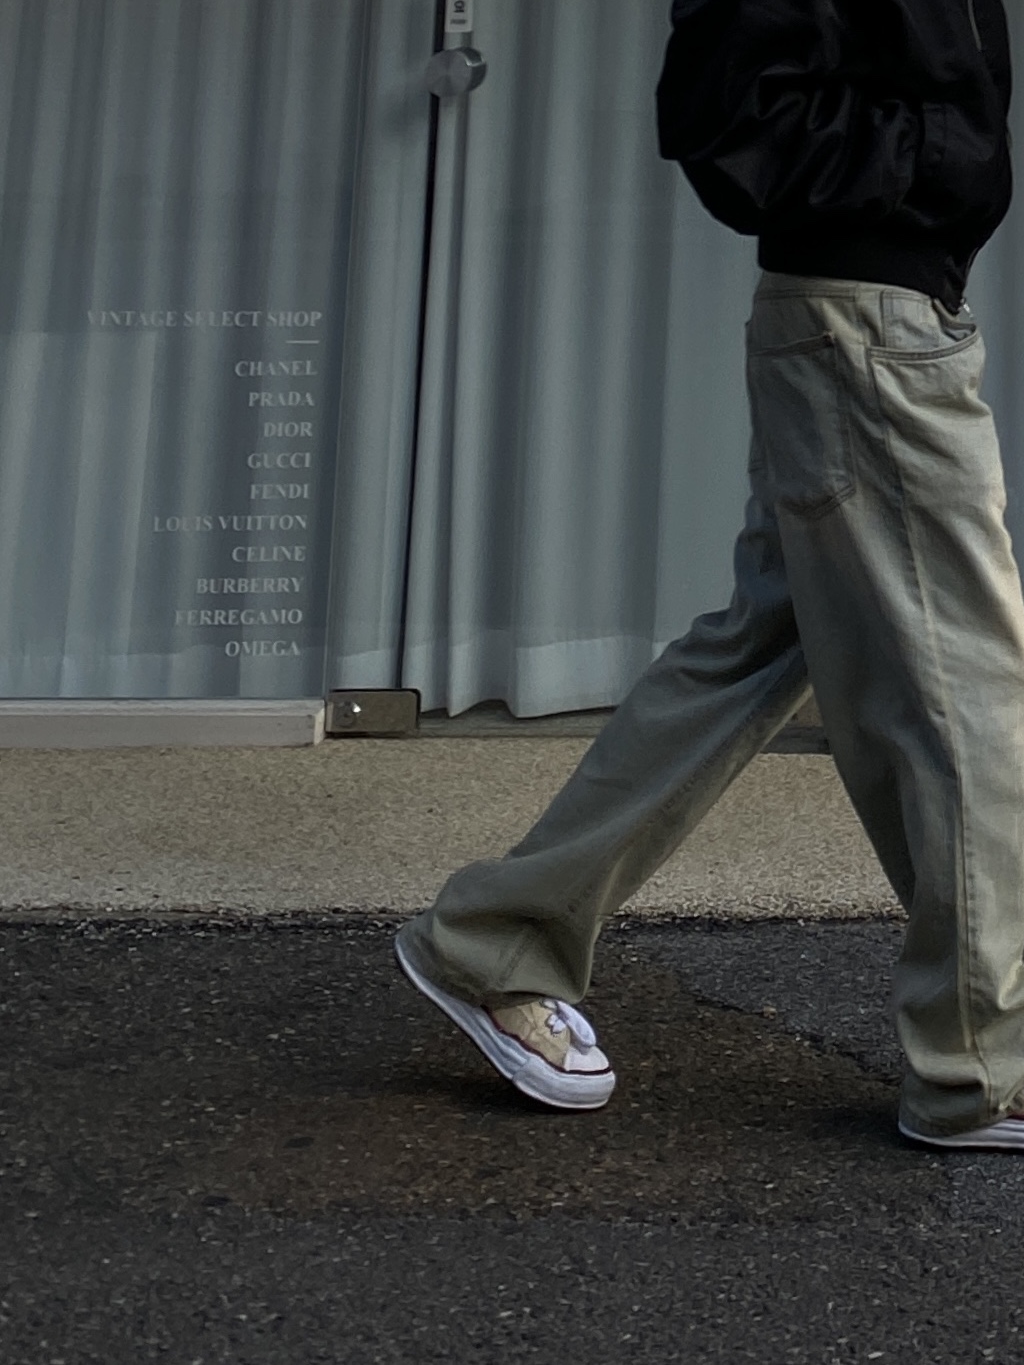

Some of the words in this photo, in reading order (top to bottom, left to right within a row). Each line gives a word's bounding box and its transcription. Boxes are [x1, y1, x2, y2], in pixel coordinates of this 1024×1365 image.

[87, 310, 177, 327] VINTAGE
[183, 310, 262, 326] SELECT
[267, 311, 322, 326] SHOP
[234, 360, 318, 377] CHANEL
[248, 391, 315, 407] PRADA
[263, 422, 313, 437] DIOR
[247, 452, 311, 469] GUCCI
[250, 483, 310, 500] FENDI
[153, 515, 212, 532] LOUIS
[219, 515, 308, 531] VUITTON
[232, 545, 307, 562] CELINE
[196, 577, 304, 594] BURBERRY
[174, 608, 303, 625] FERREGAMO
[225, 640, 302, 657] OMEGA
